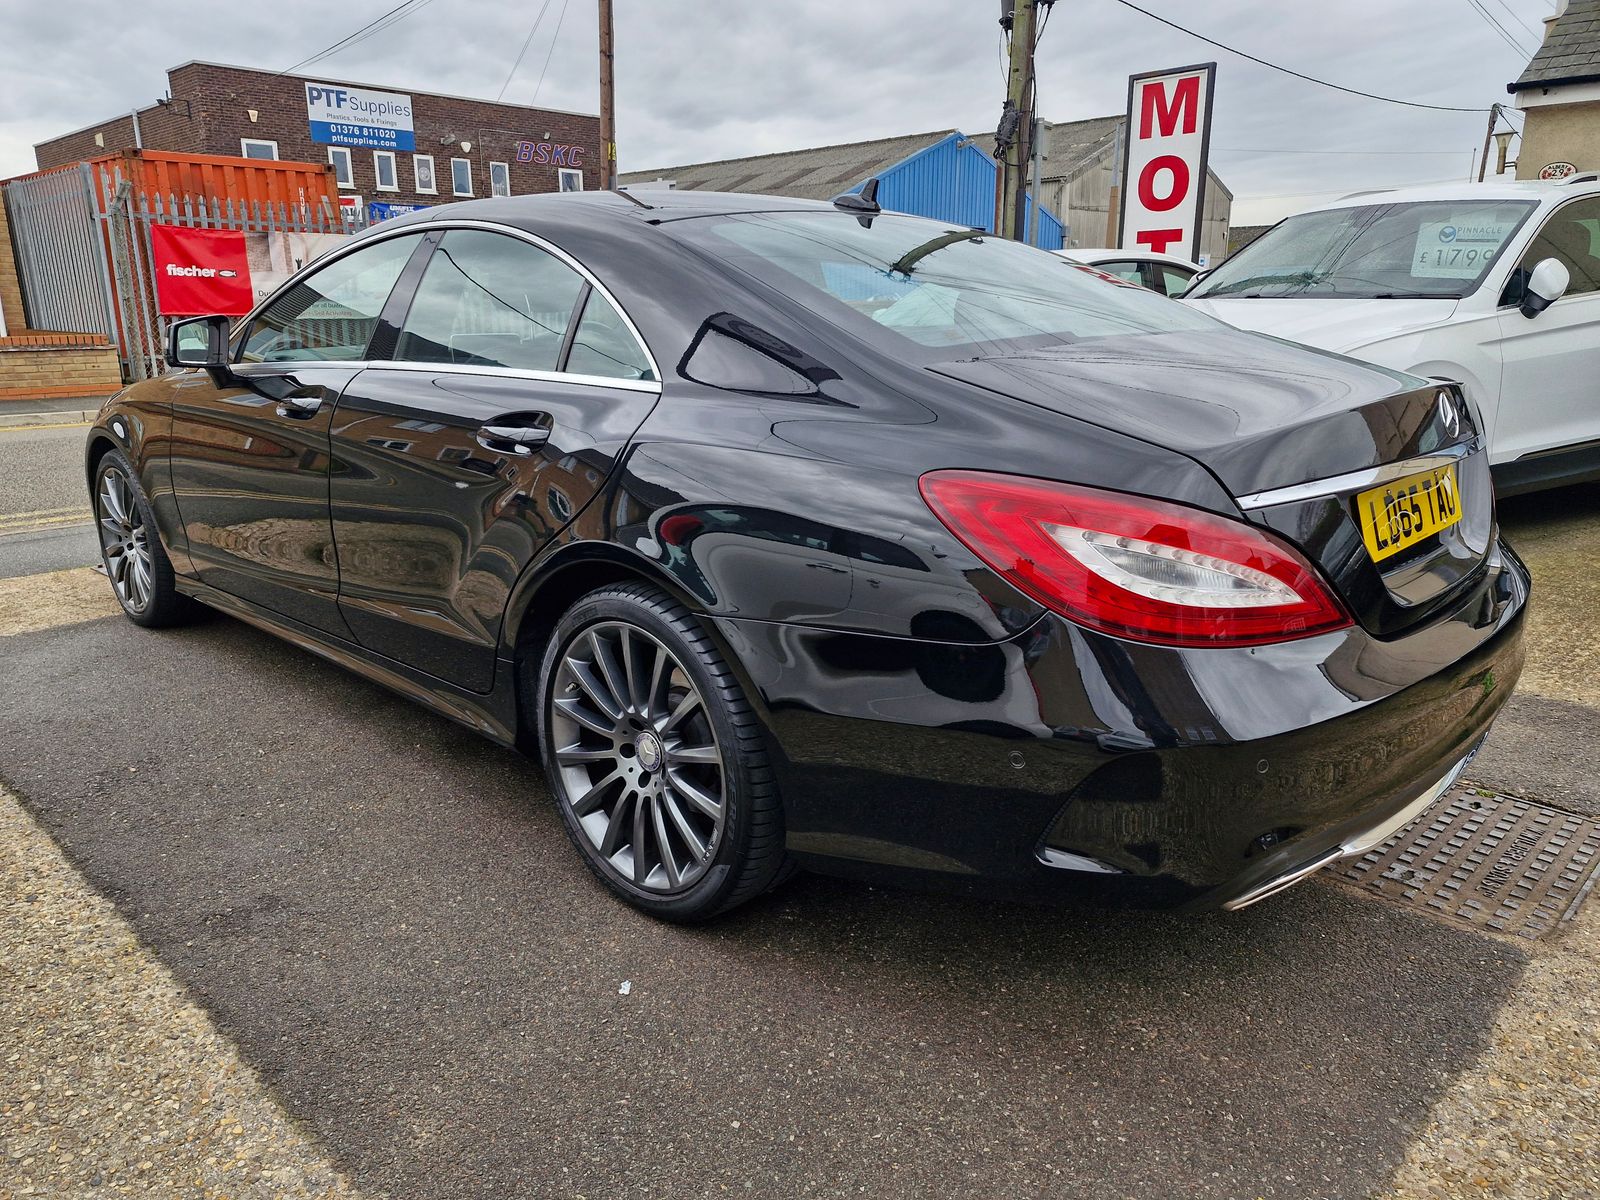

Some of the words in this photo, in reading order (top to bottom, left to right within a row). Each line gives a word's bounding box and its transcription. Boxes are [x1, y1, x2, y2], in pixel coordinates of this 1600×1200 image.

[308, 87, 347, 108] PTF
[350, 97, 411, 117] Supplies
[326, 113, 352, 121] Plastics,
[377, 118, 397, 126] Fixings
[330, 124, 360, 135] 01376
[363, 127, 396, 139] 811020
[332, 135, 397, 147] ptfsupplies.com
[516, 140, 585, 167] BSKC
[1552, 169, 1564, 177] 29
[1457, 226, 1502, 234] PINNACLE
[166, 263, 216, 277] fischer
